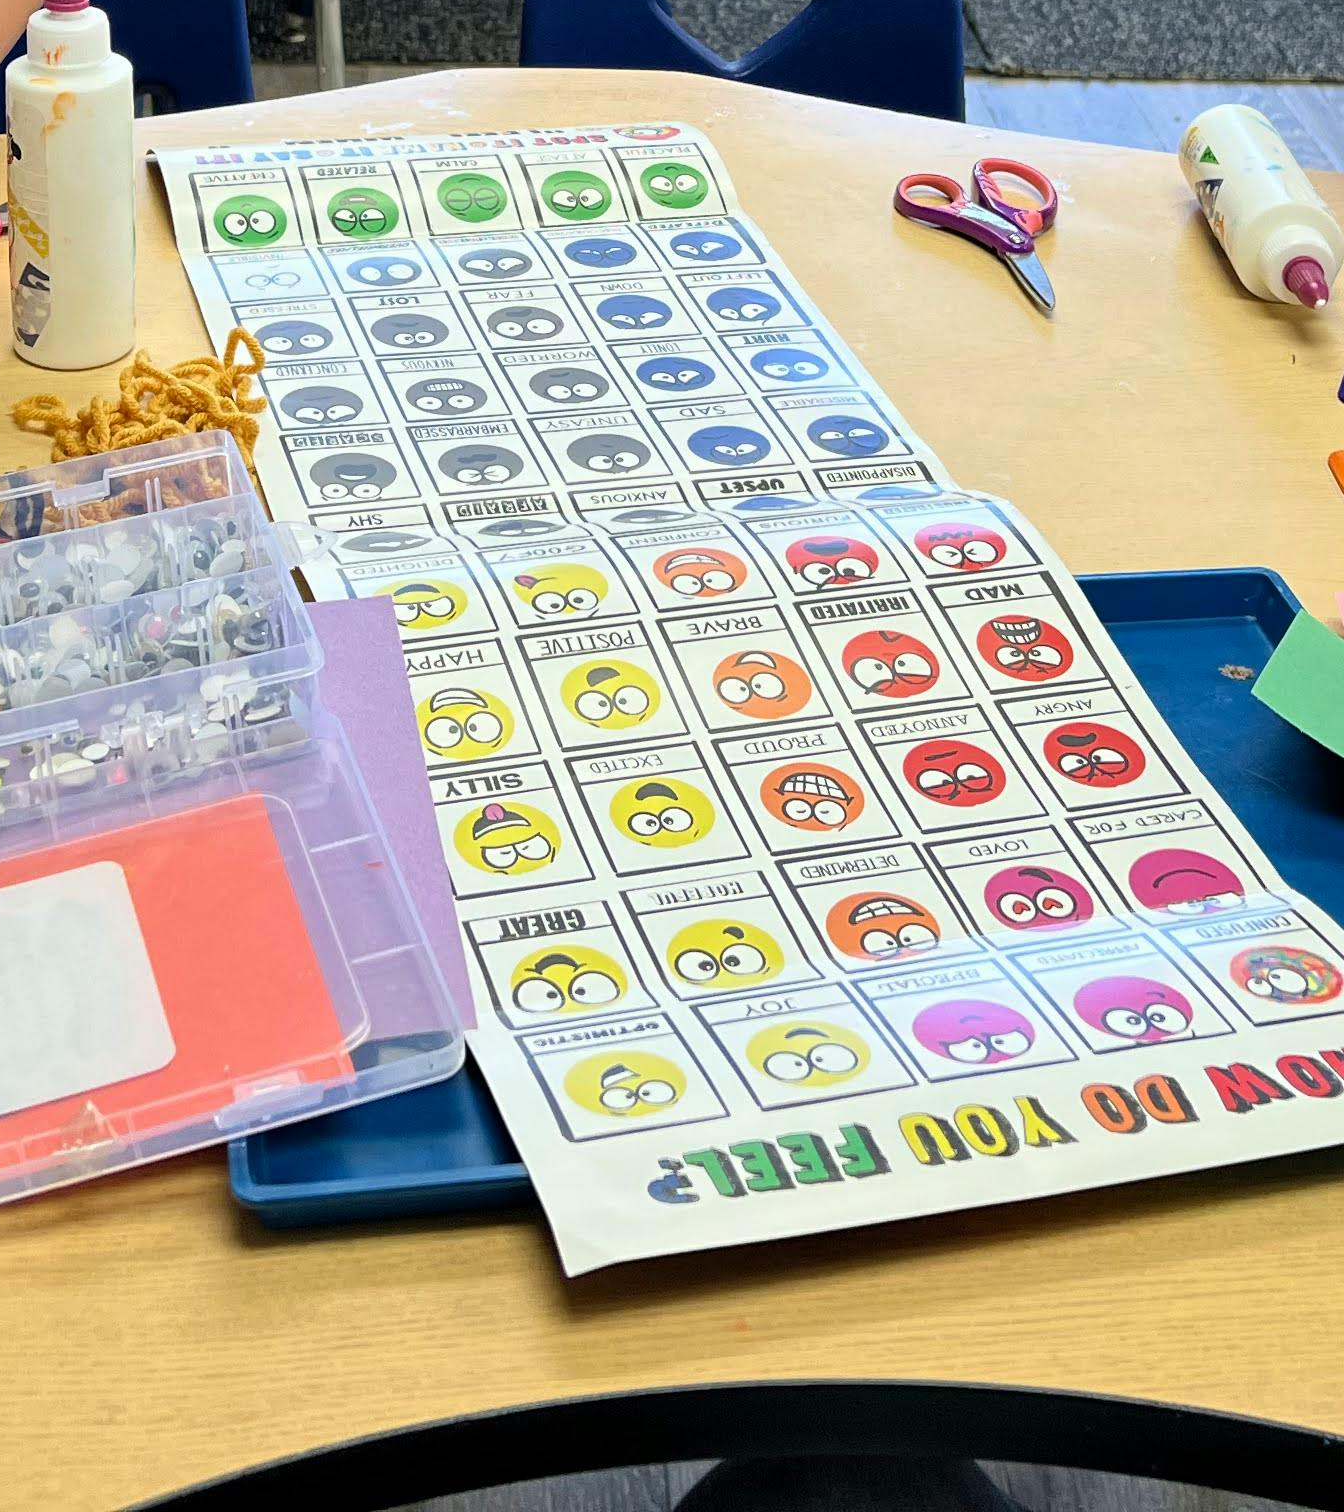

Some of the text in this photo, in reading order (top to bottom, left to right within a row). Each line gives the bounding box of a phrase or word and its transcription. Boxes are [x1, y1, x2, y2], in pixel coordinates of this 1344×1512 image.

[625, 146, 692, 157] PEACEFUL
[316, 165, 377, 177] RELAXED
[435, 160, 479, 169] CALM
[204, 171, 276, 184] CREATIVE
[646, 220, 724, 231] DEFEATED
[690, 272, 762, 283] LEFT OUT
[486, 289, 534, 300] FEAR
[599, 281, 644, 292] DOWN
[249, 303, 318, 315] STRESSED
[377, 296, 420, 307] LOST
[741, 333, 792, 345] HURT
[639, 342, 681, 354] LONELY
[401, 357, 455, 371] NERVOUS
[503, 351, 596, 364] WORRIED
[275, 362, 348, 377] CONCERNED
[778, 396, 857, 408] MISERABLE
[680, 405, 726, 418] SAD
[413, 422, 509, 439] EMBARRASSED
[544, 415, 628, 430] UNEASY
[292, 432, 384, 448] SCARED
[826, 465, 916, 483] DISAPPOINTED
[719, 478, 785, 494] UPSET
[589, 489, 667, 505] ANXIOUS
[455, 496, 548, 517] AFRAID
[347, 513, 383, 528] SHY
[758, 514, 852, 530] FURIOUS
[627, 529, 721, 546] CONFIDENT
[498, 545, 586, 562] GOOFY
[351, 558, 455, 576] DELIGHTED
[964, 583, 1025, 601] MAD
[808, 595, 910, 620] IRRITATED
[686, 615, 764, 635] BRAVE
[536, 630, 635, 656] POSITIVE
[406, 648, 485, 672] HAPPY
[1032, 698, 1093, 716] ANGRY
[869, 714, 968, 738] ANNOYED
[743, 733, 825, 755] PROUD
[588, 753, 664, 774] EXCITED
[444, 772, 524, 798] SILLY
[1082, 809, 1203, 836] CARED FOR
[968, 838, 1029, 857] LOVED
[799, 854, 899, 879] DETERMINED
[646, 880, 744, 906] HOPEFUL
[498, 908, 586, 941] GREAT
[1193, 914, 1292, 938] CONFUSED
[1036, 941, 1140, 966] APPRECIATED
[877, 967, 981, 993] SPECIAL
[744, 998, 794, 1019] JOY
[532, 1022, 660, 1048] OPTIMISTIC
[1080, 1074, 1201, 1135] DO
[898, 1095, 1080, 1166] YOU
[647, 1122, 892, 1205] FEEL?
